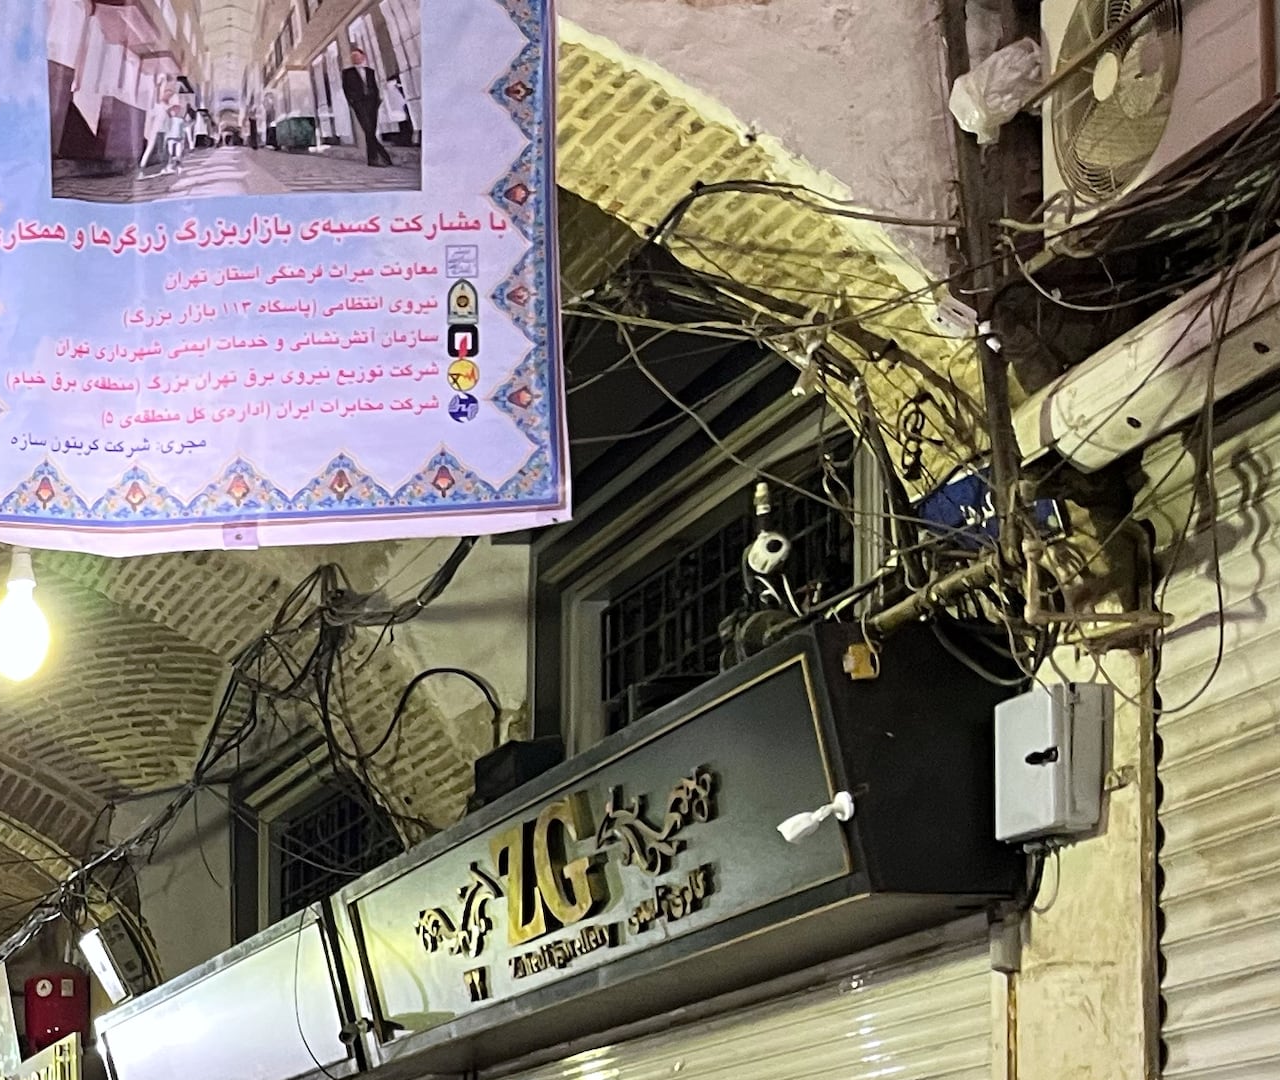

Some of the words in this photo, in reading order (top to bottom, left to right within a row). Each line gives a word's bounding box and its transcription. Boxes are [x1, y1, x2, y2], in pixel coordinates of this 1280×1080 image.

[390, 211, 481, 241] مشارکت
[489, 211, 508, 239] با
[72, 228, 85, 250] و
[91, 224, 168, 254] زرگرها
[165, 270, 208, 291] تهران
[215, 265, 260, 286] استان
[265, 264, 324, 285] فرهنگی
[329, 263, 375, 283] میراث
[380, 261, 439, 281] معاونت
[178, 304, 216, 325] بازار
[223, 302, 252, 315] ۱۱۳
[322, 298, 384, 318] انتظامی
[389, 298, 439, 315] نیروی
[167, 337, 212, 359] ایمنی
[216, 334, 269, 351] خدمات
[276, 339, 284, 352] و
[381, 329, 439, 348] سازمان
[55, 339, 90, 359] تهران
[94, 341, 163, 363] شهرداری
[51, 371, 78, 392] برق
[195, 371, 238, 391] تهران
[243, 367, 275, 388] برق
[281, 370, 331, 388] نیروی
[336, 366, 384, 386] توزیع
[389, 361, 440, 382] شرکت
[146, 375, 190, 395] بزرگ
[276, 399, 314, 419] ایران
[319, 398, 385, 417] مخابرات
[389, 394, 440, 415] شرکت
[185, 407, 206, 424] کل
[10, 432, 47, 451] سازه
[103, 437, 151, 458] شرکت
[489, 794, 600, 948] ZG
